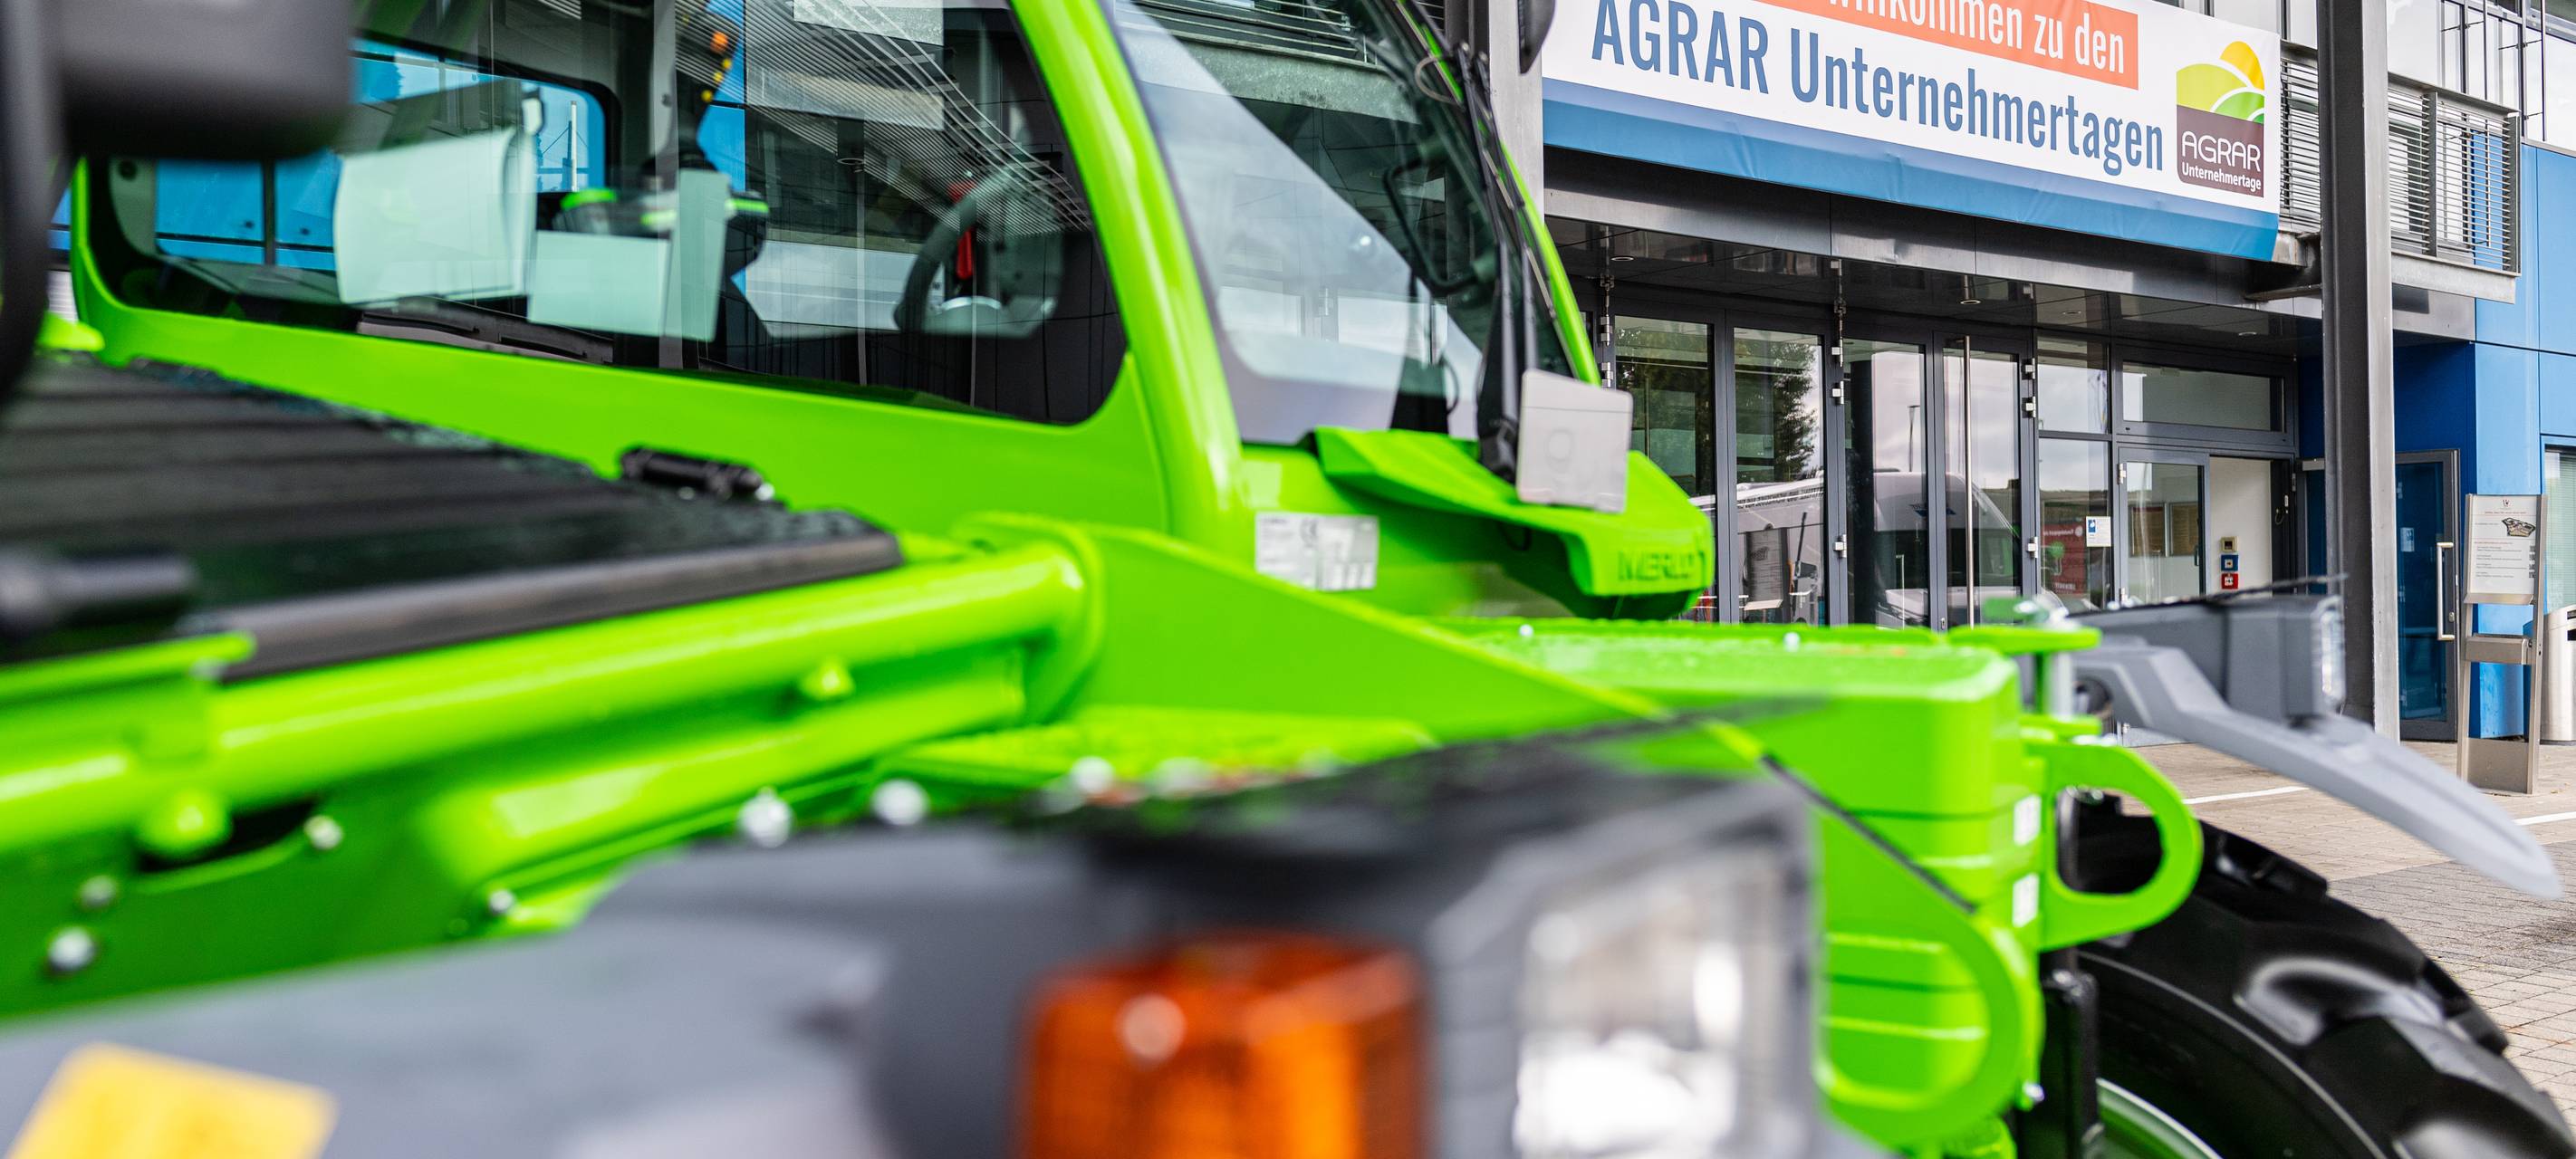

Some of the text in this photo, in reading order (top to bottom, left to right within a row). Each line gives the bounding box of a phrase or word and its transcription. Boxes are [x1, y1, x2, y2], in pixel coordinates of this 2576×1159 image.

[2033, 14, 2064, 60] zu
[2074, 12, 2124, 74] den
[1591, 0, 2163, 177] AGRAR Unternehmertagen
[2181, 130, 2262, 173] AGRAR
[2181, 161, 2262, 192] Unternehmertage
